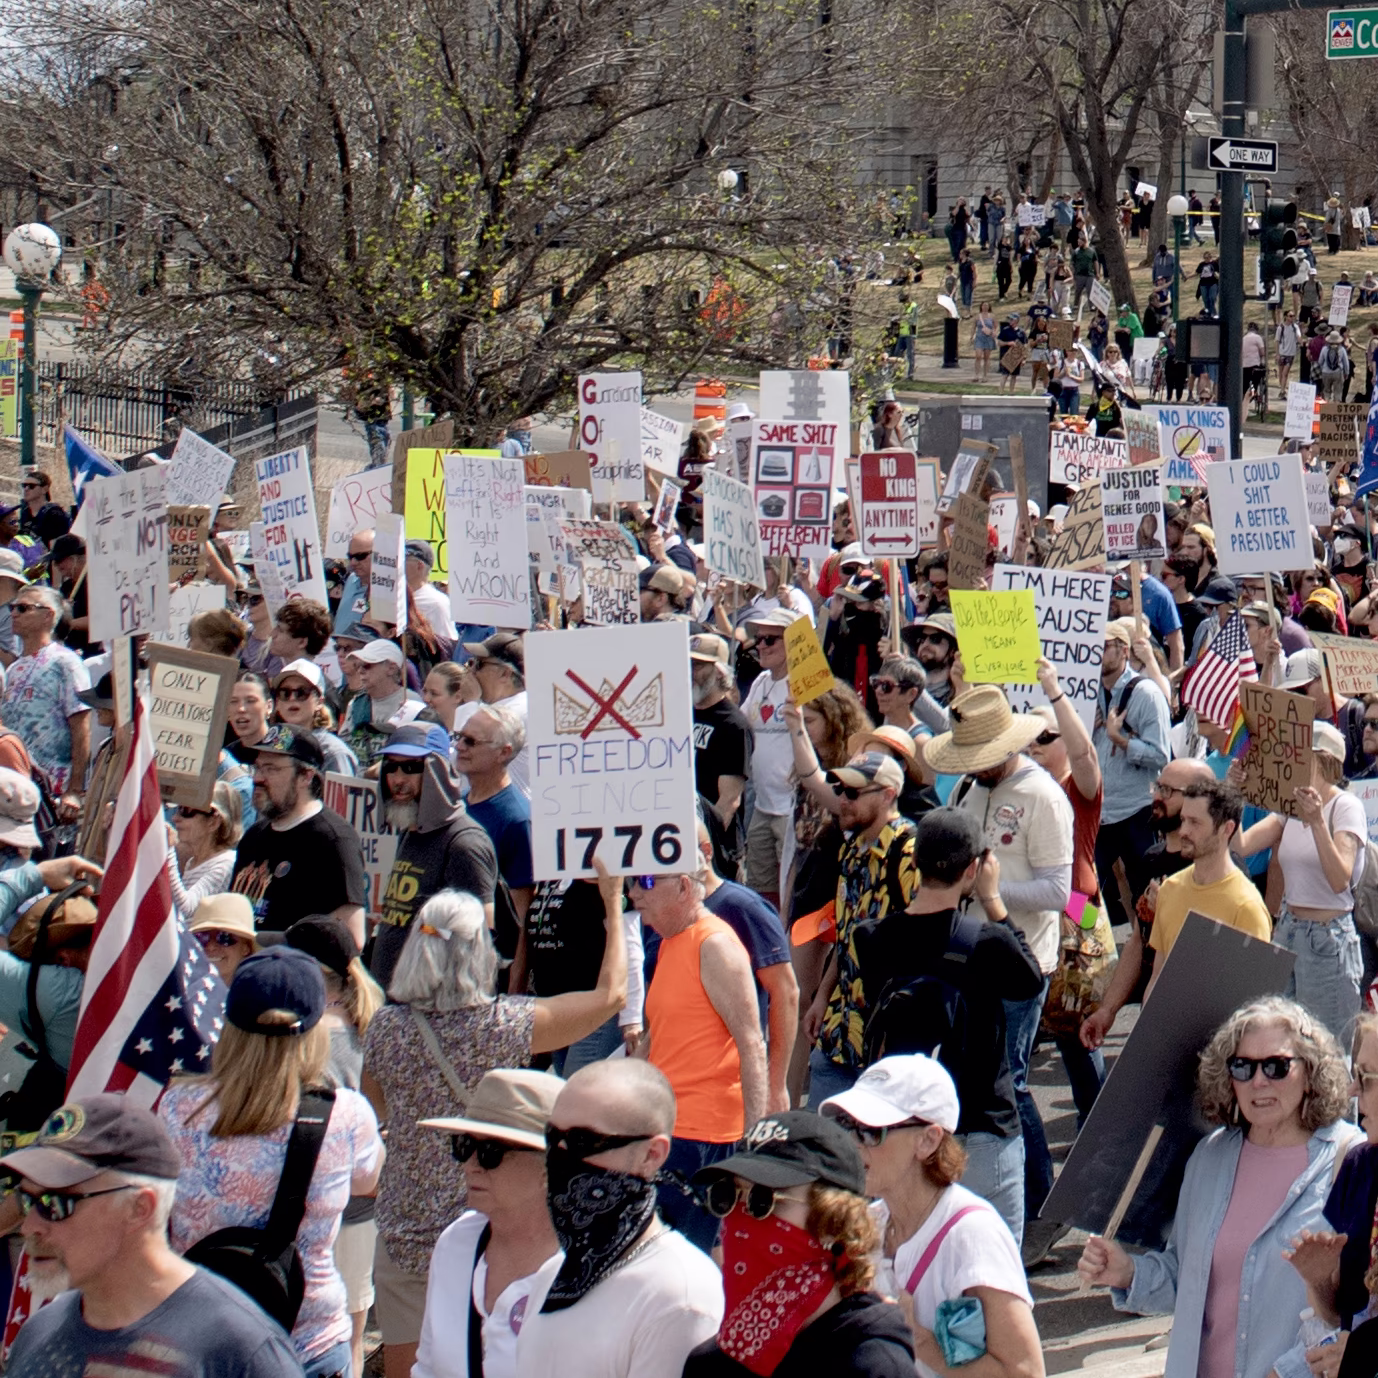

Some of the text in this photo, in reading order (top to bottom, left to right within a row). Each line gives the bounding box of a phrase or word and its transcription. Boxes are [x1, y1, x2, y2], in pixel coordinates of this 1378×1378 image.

[1229, 148, 1271, 163] ONE WAY
[1159, 409, 1225, 428] NO KINGS
[1337, 404, 1362, 413] STOP
[759, 424, 837, 445] SAME SHIT
[255, 451, 299, 480] LIBERTY
[879, 458, 896, 476] NO
[1229, 462, 1280, 484] I COULD
[885, 480, 915, 497] KING
[1103, 469, 1160, 490] JUSTICE
[260, 480, 281, 501] AND
[1123, 489, 1140, 501] FOR
[1244, 485, 1270, 504] SHIT
[262, 495, 308, 524] JUSTICE
[865, 508, 915, 528] ANYTIME
[1104, 502, 1161, 516] RENEE GOOD
[1235, 507, 1290, 528] A BETTER
[265, 525, 287, 545] FOR
[760, 525, 831, 545] DIFFERENT
[1107, 523, 1135, 536] KILLED
[769, 542, 801, 558] HAT
[1108, 535, 1135, 547] BY ICE
[1231, 530, 1296, 552] PRESIDENT
[453, 571, 529, 604] WRONG
[161, 670, 207, 693] ONLY
[1336, 678, 1347, 691] in
[1352, 676, 1372, 690] the
[151, 698, 213, 722] DICTATORS
[156, 728, 193, 750] FEAR
[537, 736, 691, 776] FREEDOM
[542, 777, 674, 816] SINCE
[556, 823, 682, 872] 1776
